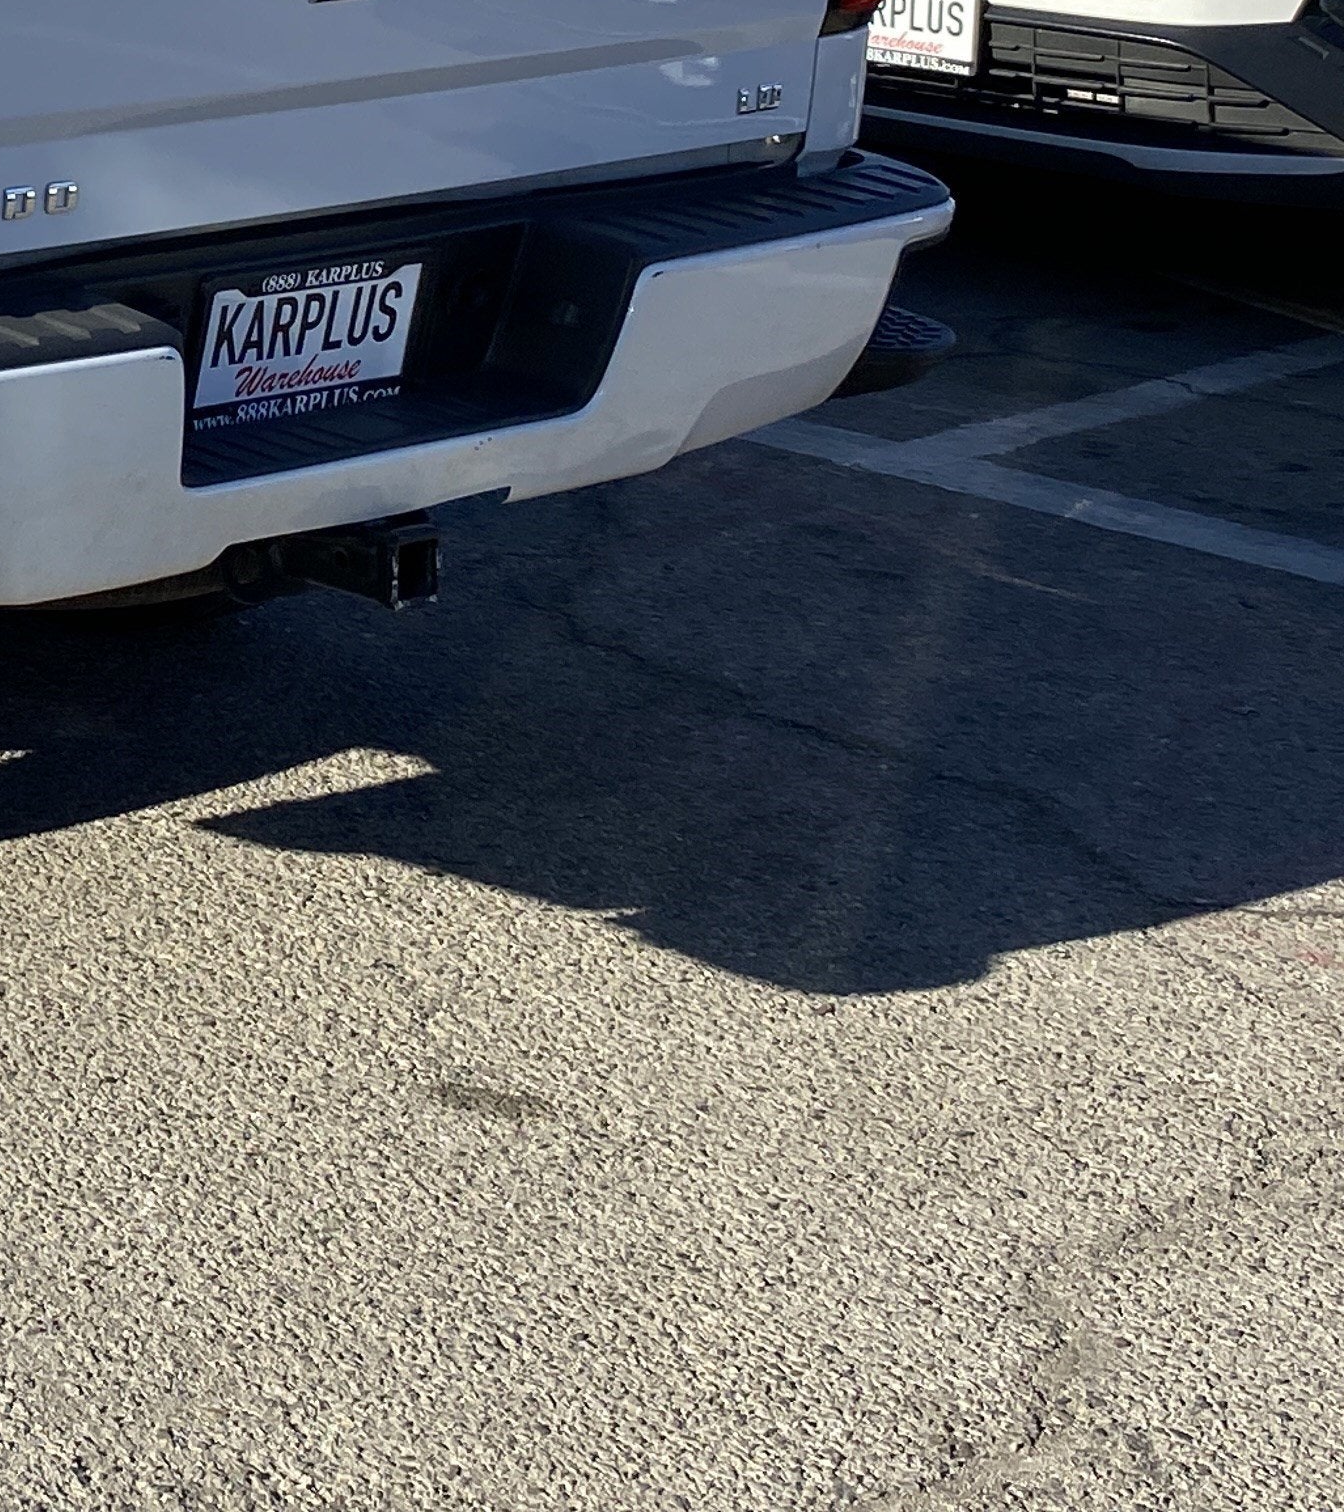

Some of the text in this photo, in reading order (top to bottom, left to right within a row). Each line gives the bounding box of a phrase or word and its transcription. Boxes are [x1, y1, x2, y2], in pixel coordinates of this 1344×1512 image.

[870, 31, 944, 54] arehouse
[262, 260, 385, 293] (888) KARPLUS
[209, 280, 403, 369] KARPLUS
[234, 353, 362, 398] Warehouse
